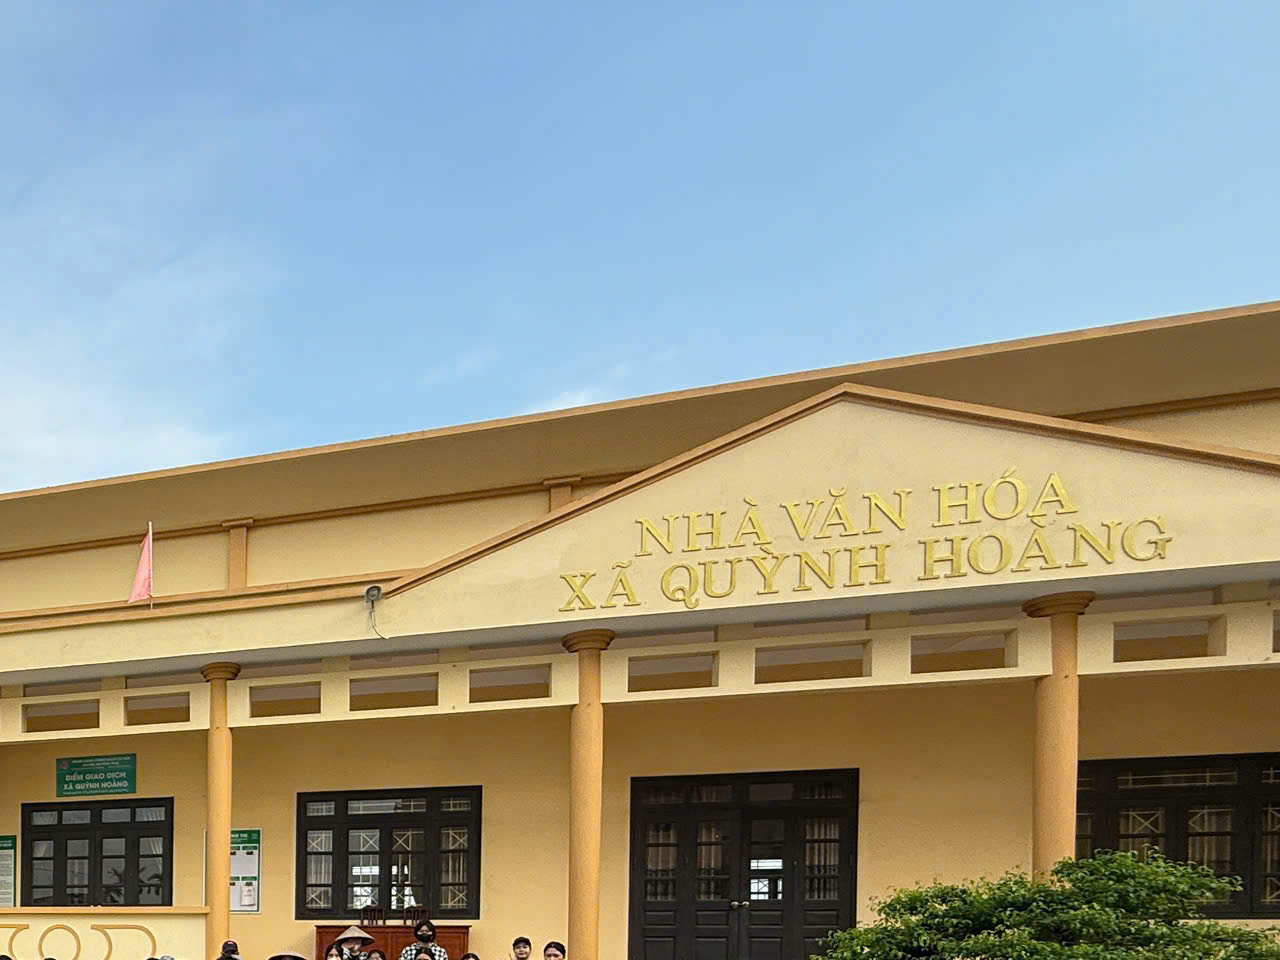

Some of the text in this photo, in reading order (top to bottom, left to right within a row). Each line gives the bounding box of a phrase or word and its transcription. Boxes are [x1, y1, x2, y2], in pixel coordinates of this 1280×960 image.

[635, 468, 1079, 557] NHÀ VĂN HÓA
[558, 512, 1172, 612] XÃ QUỲNH HOÀNG
[106, 772, 126, 780] DỊCH
